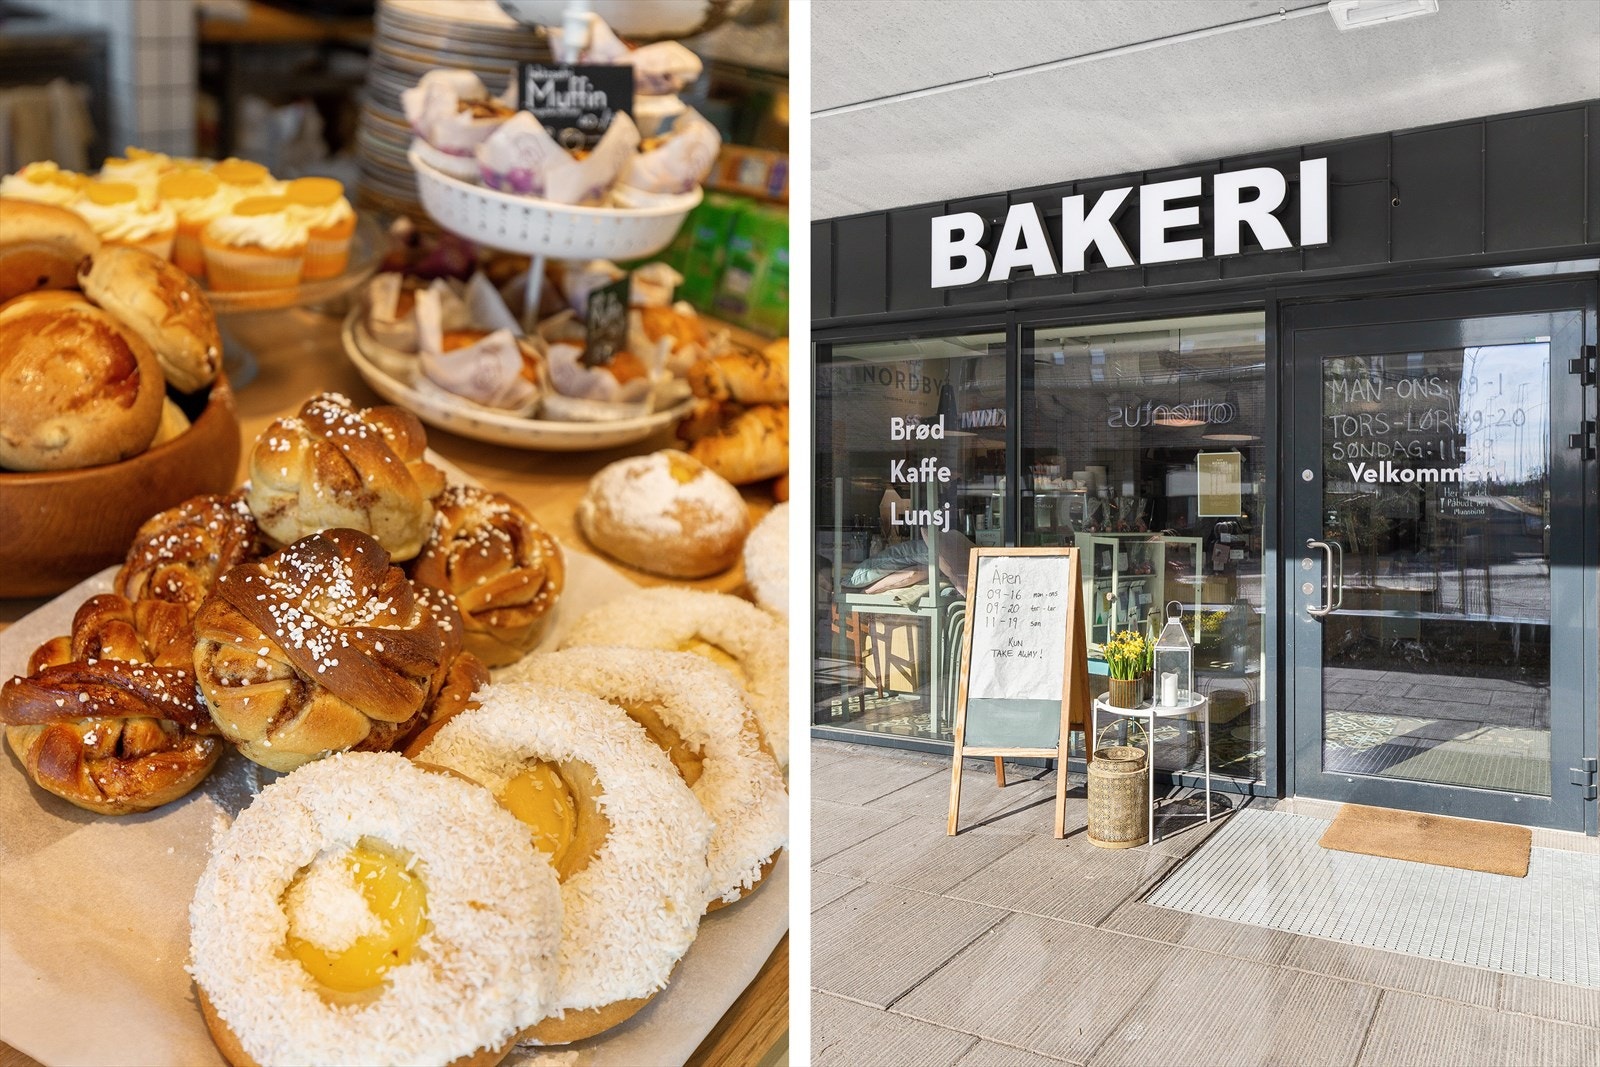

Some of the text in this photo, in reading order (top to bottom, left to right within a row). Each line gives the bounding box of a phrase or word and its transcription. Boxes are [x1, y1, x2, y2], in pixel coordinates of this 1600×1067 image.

[525, 75, 607, 109] Muffin
[931, 157, 1329, 288] BAKERI
[863, 365, 943, 396] NORDBY
[890, 413, 945, 440] Brød
[1332, 439, 1433, 461] SØNDAG:
[890, 457, 952, 483] Kaffe
[1347, 460, 1507, 483] Velkommen!
[890, 501, 951, 533] Lunsj
[991, 648, 1013, 658] TAKE
